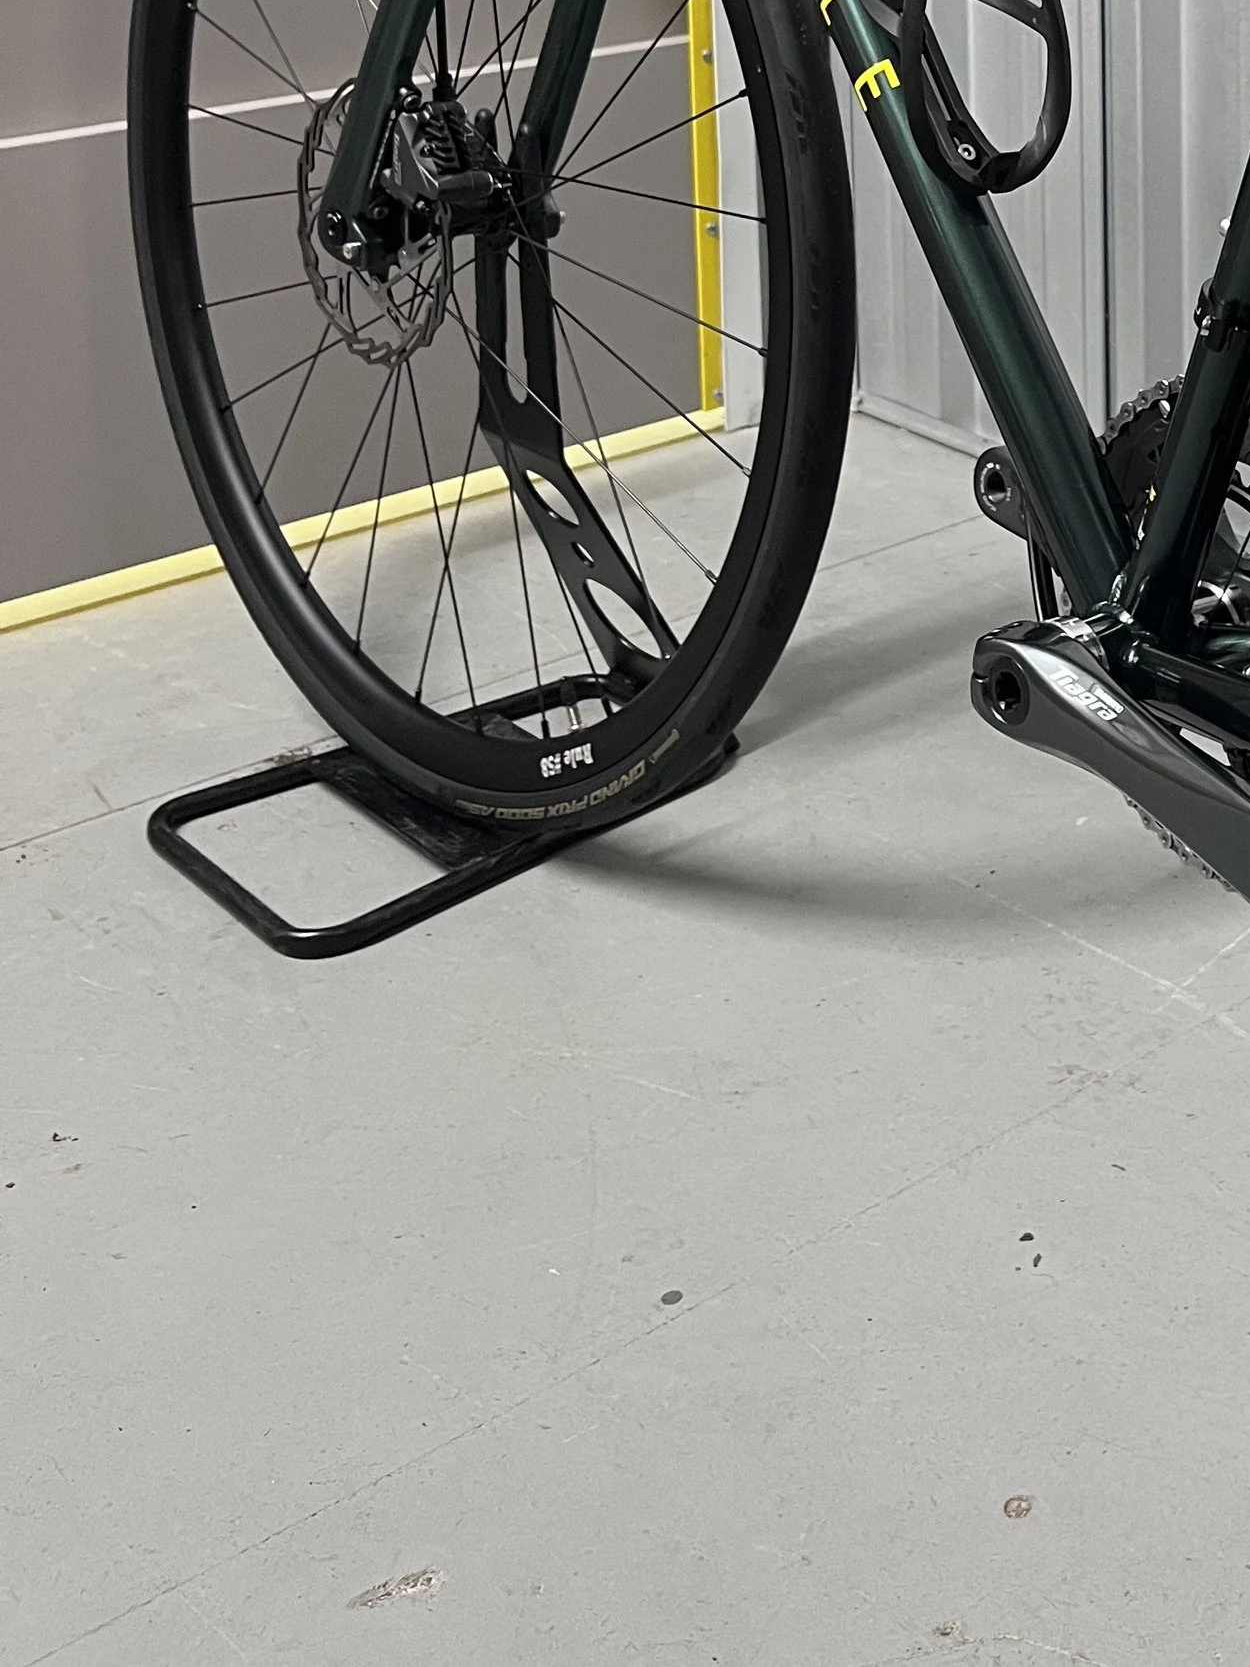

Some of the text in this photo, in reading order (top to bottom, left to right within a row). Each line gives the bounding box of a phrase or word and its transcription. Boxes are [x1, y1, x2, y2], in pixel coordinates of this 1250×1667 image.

[1048, 664, 1118, 721] Tiagra
[563, 742, 594, 769] Rule
[590, 759, 646, 805] GRAND
[495, 806, 546, 820] 5000
[547, 795, 588, 817] PRIX
